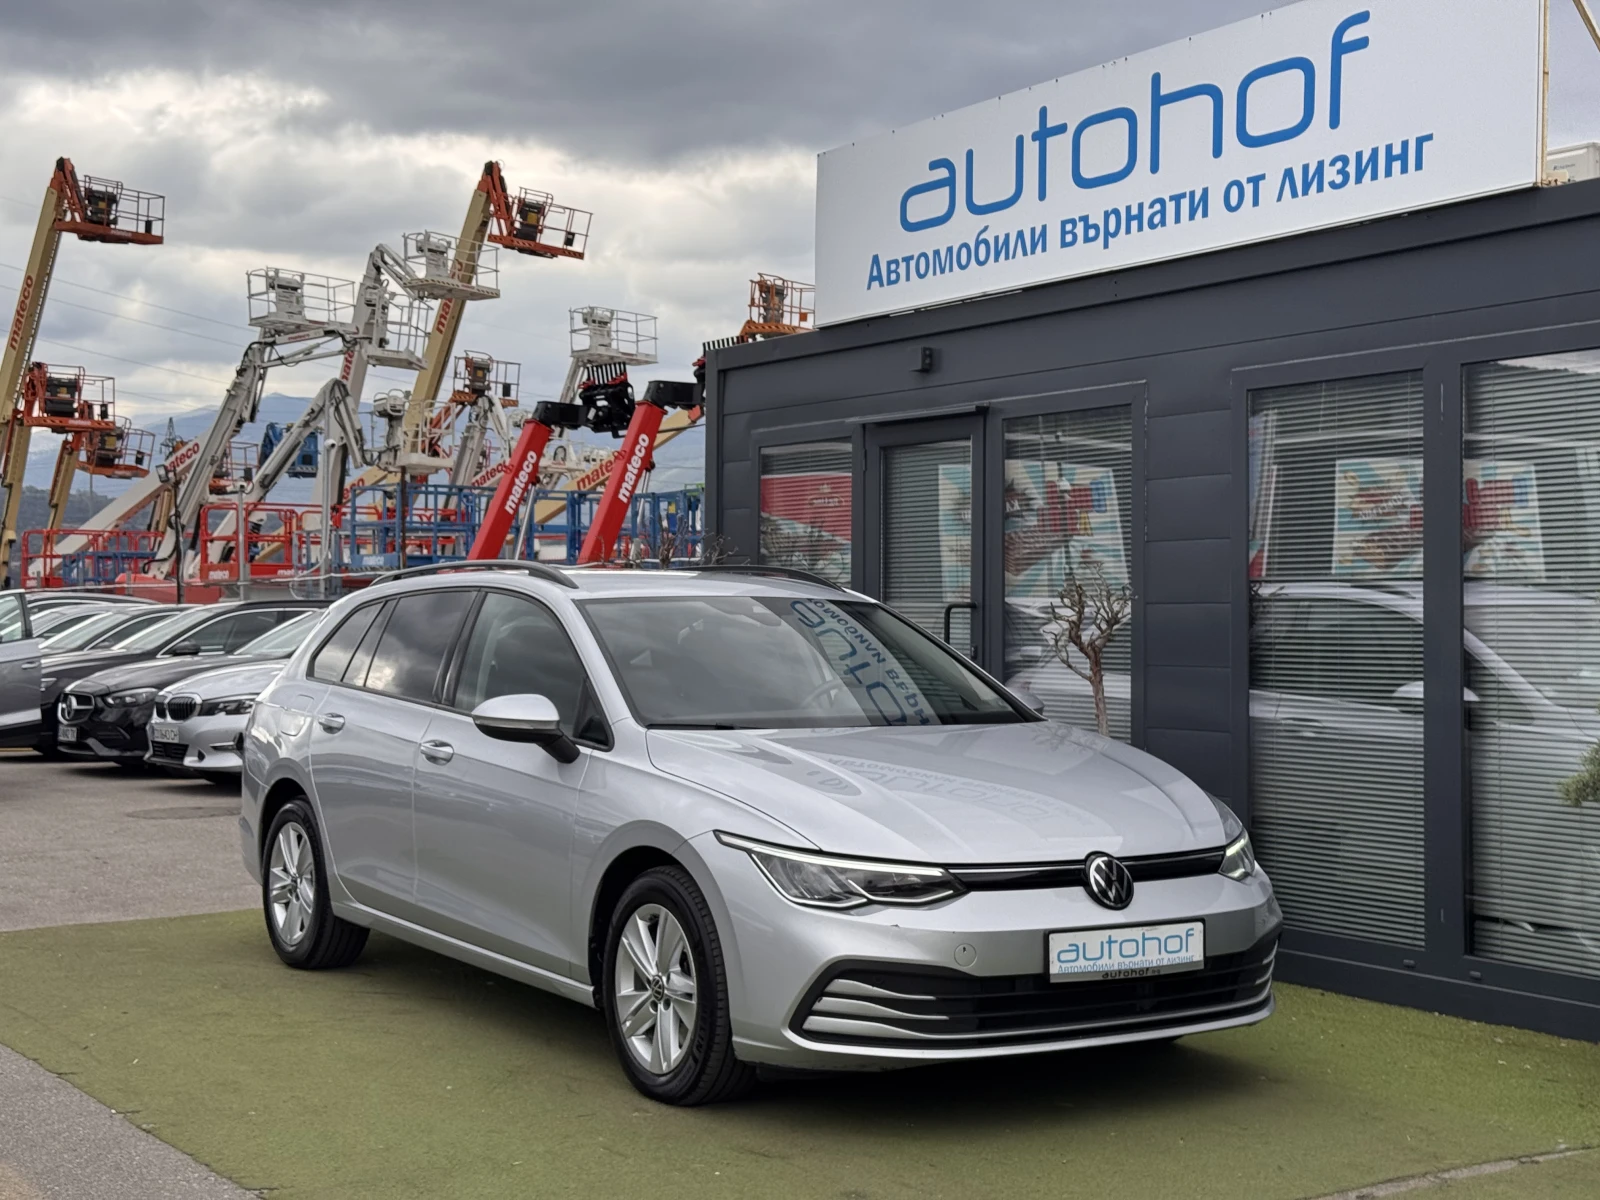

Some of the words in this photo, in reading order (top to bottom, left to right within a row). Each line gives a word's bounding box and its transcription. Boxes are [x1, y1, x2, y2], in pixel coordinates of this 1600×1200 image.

[899, 10, 1370, 232] autohof
[866, 223, 1048, 290] Автомобили
[1059, 186, 1210, 250] върнати
[1223, 173, 1267, 213] от
[1276, 133, 1434, 203] лизинг
[10, 274, 34, 351] mateco
[504, 450, 537, 515] mateco
[617, 433, 649, 504] mateco
[1057, 927, 1195, 963] autohof
